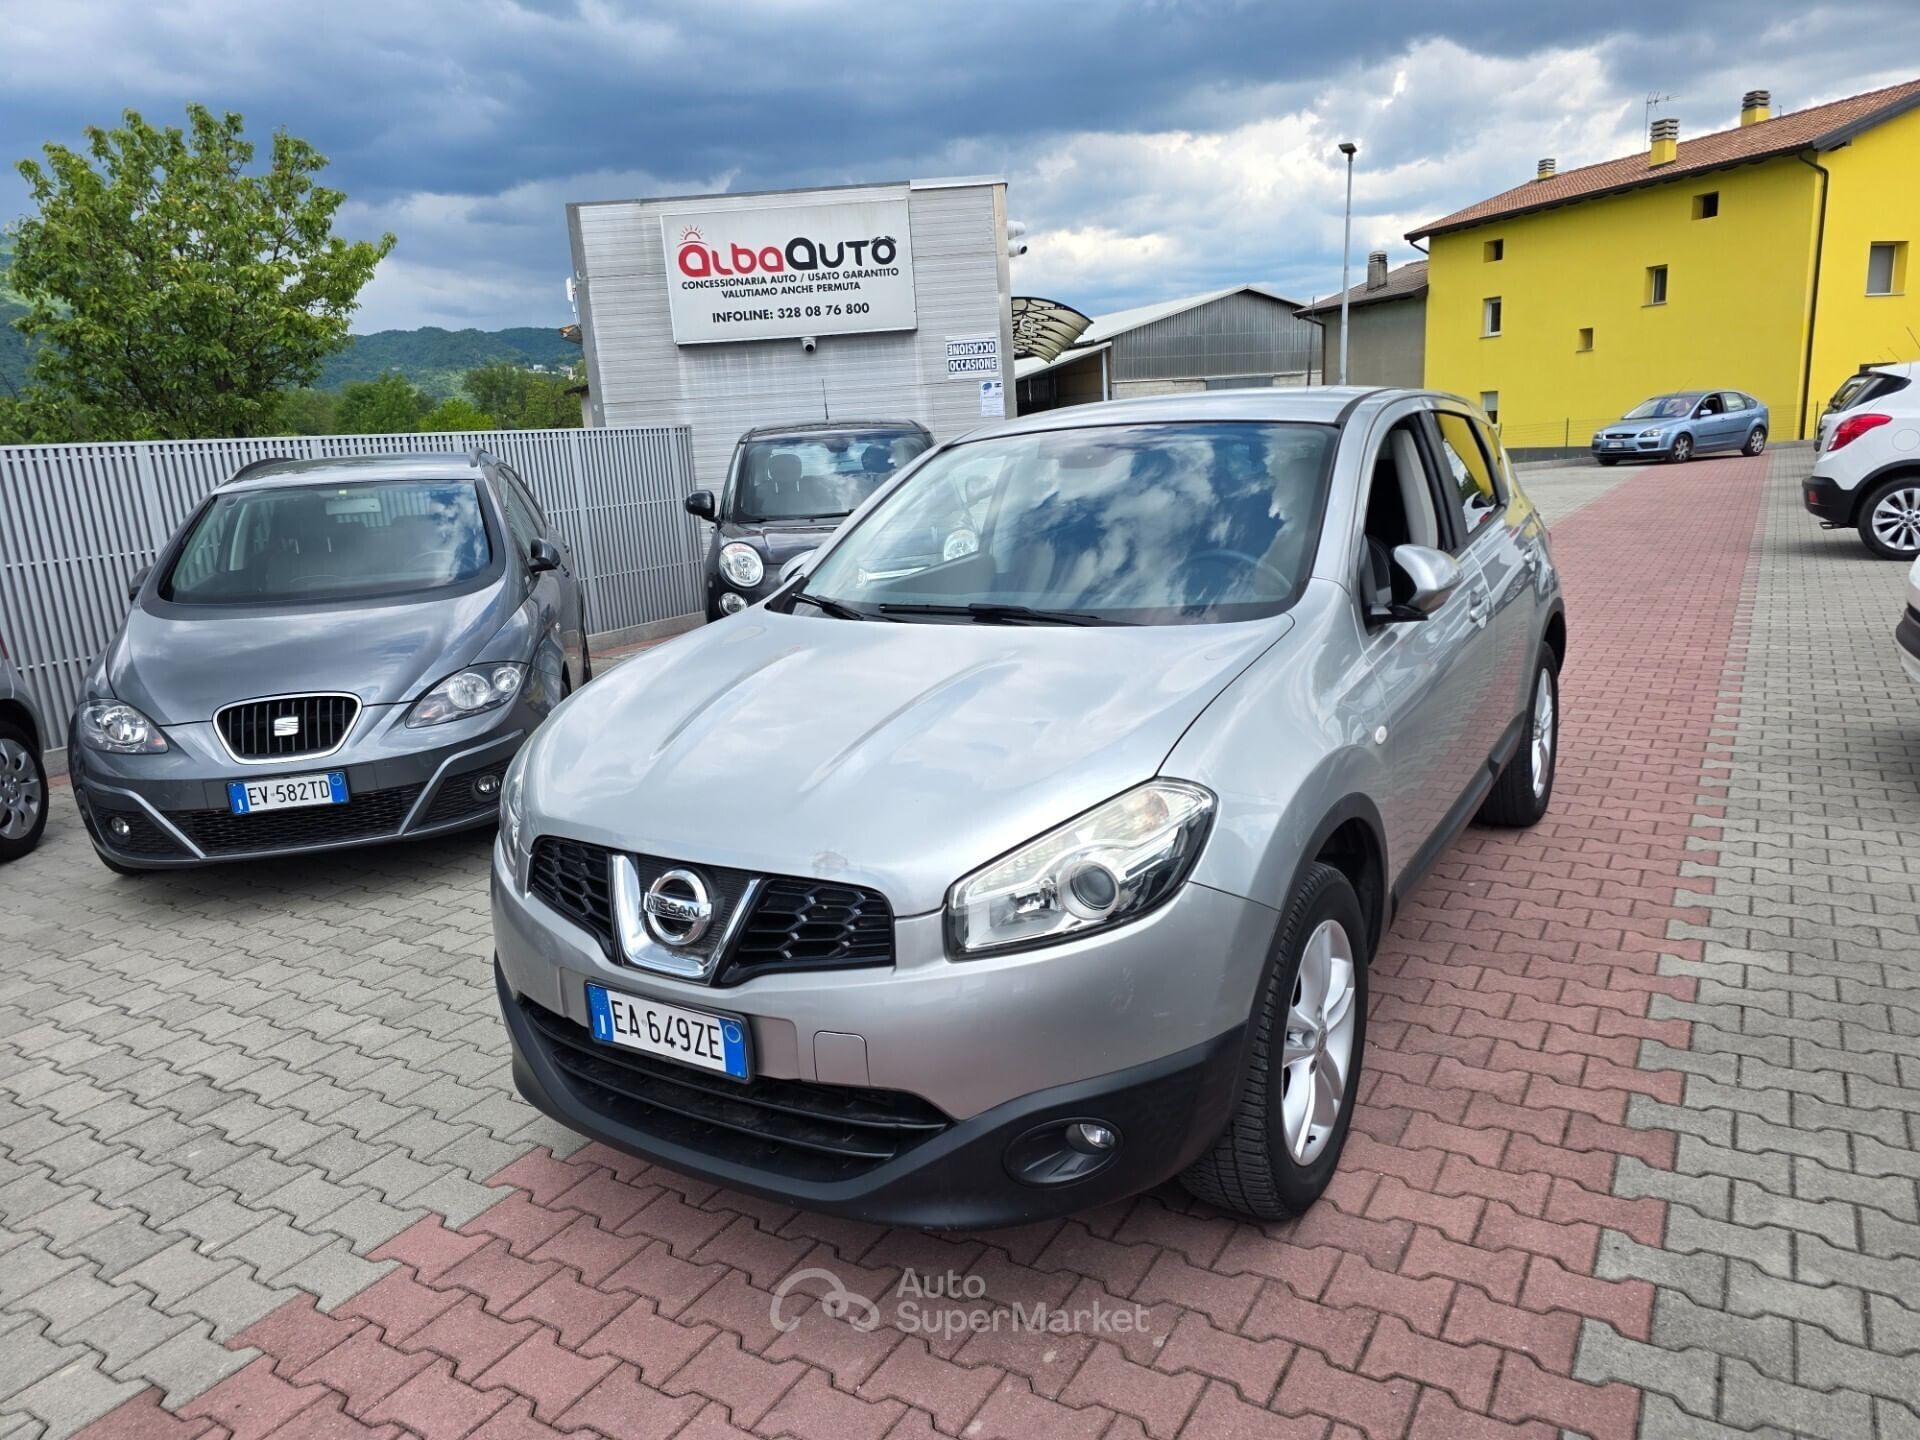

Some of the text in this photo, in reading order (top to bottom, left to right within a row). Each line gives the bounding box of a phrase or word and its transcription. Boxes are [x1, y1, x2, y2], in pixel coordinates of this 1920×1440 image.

[681, 275, 767, 290] CONCESSIONARIA
[770, 273, 797, 284] AUTO
[807, 271, 840, 282] USATO
[842, 267, 899, 279] GARANTITO
[721, 281, 861, 299] VALUTIAMO ANCHE PERMUTA
[712, 302, 870, 323] INFOLINE: 328 08 76 800
[948, 342, 994, 355] OCCASIONE
[949, 358, 996, 371] OCCASIONE
[646, 894, 700, 918] NISSAN
